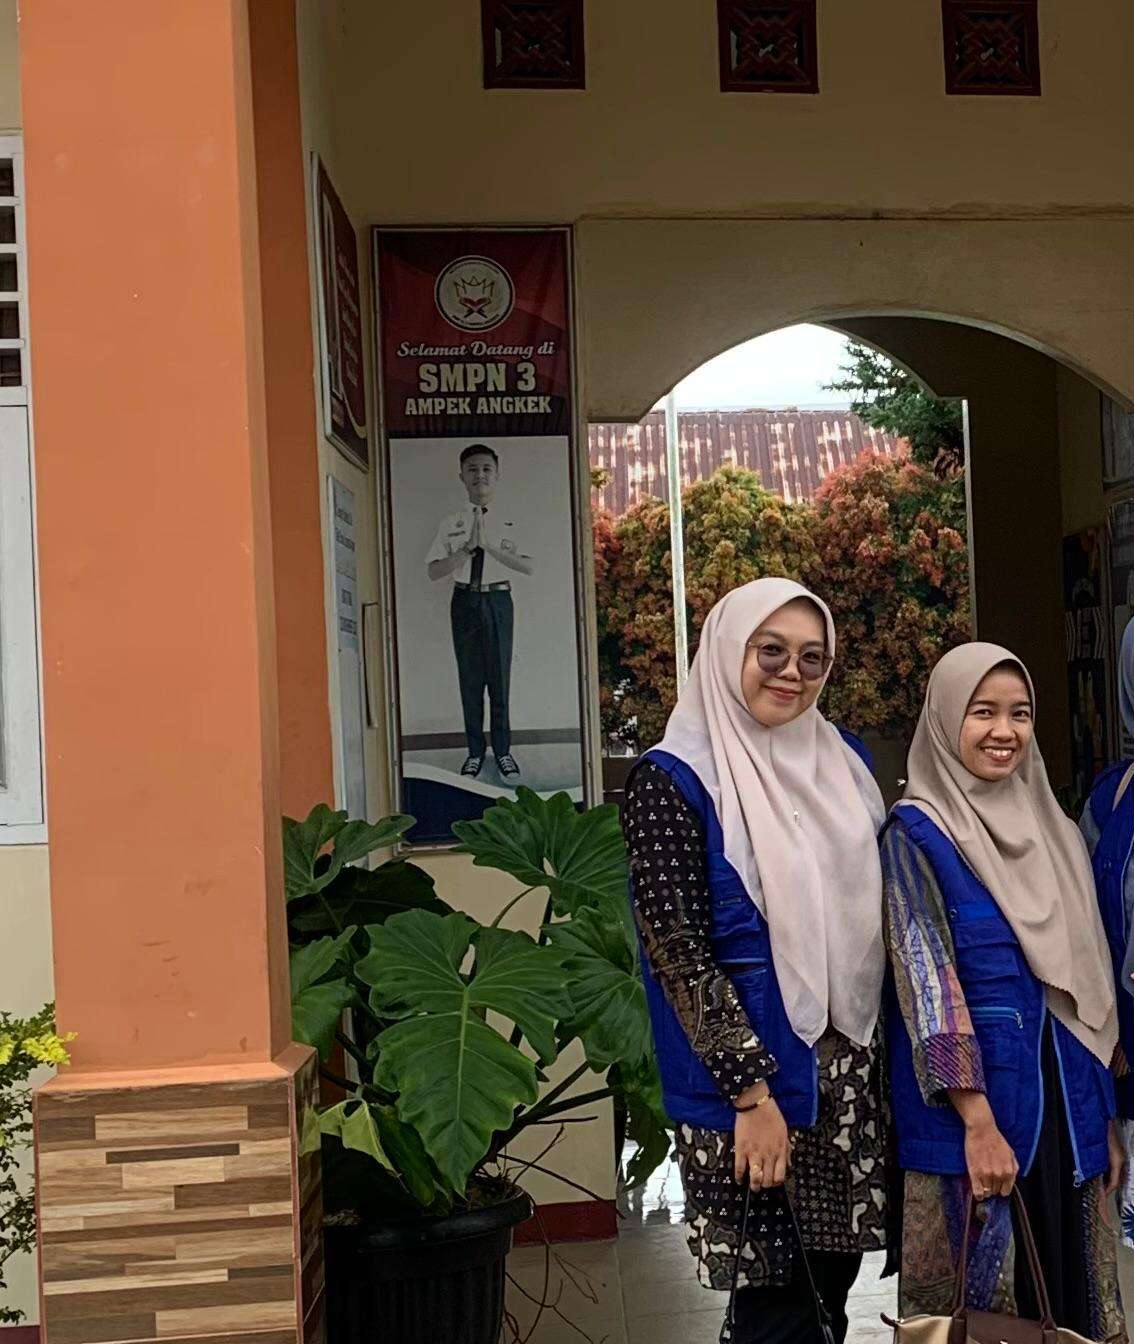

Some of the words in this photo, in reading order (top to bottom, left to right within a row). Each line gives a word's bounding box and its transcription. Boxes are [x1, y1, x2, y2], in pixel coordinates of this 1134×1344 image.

[397, 341, 466, 356] Selamat
[470, 341, 533, 359] Datang
[537, 342, 554, 355] di
[419, 363, 506, 392] SMPN
[516, 361, 536, 391] 3
[405, 397, 471, 414] AMPEK
[476, 396, 551, 414] ANGKEK
